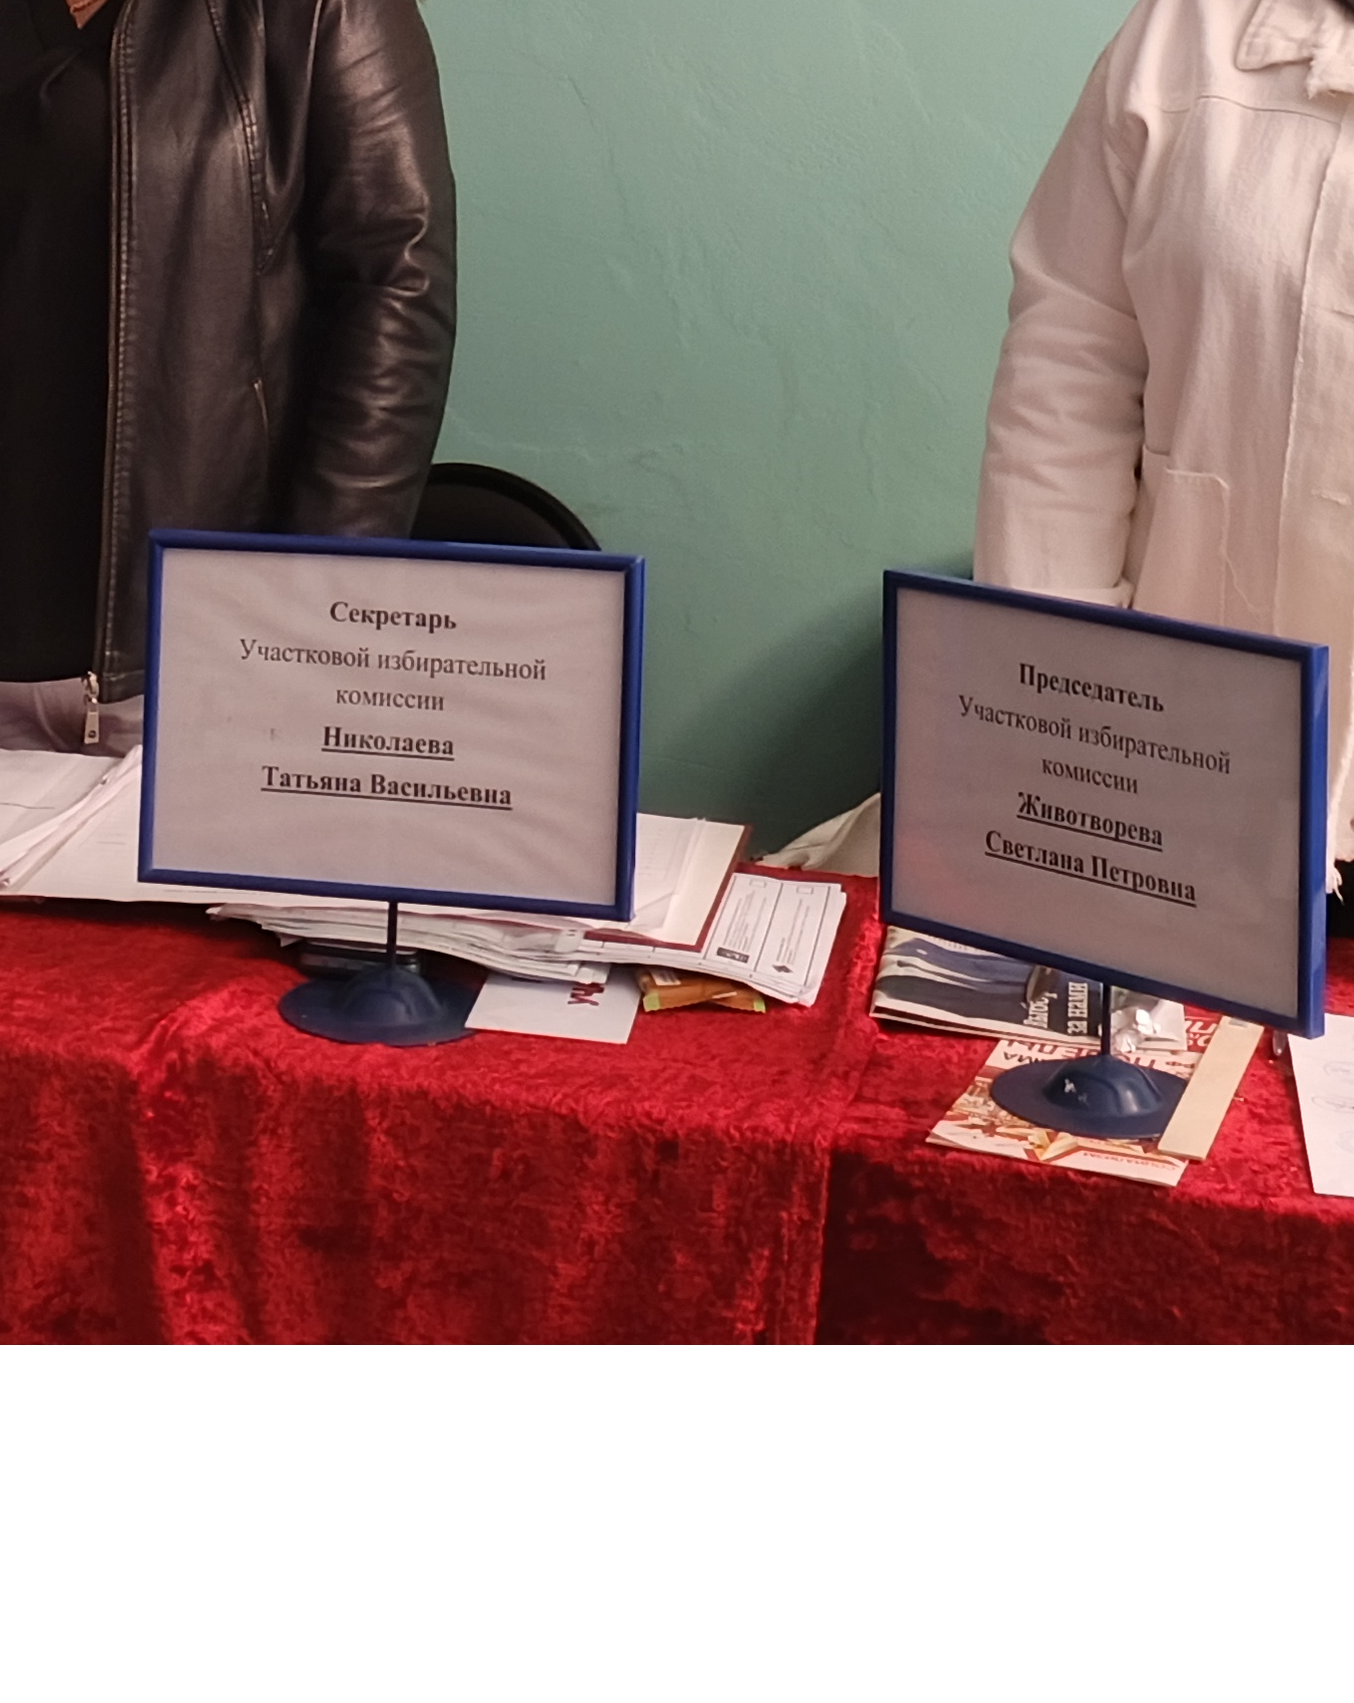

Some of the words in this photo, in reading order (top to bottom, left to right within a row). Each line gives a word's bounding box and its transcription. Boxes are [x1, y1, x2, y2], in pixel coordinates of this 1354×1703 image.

[329, 601, 457, 634] Секретарь
[239, 638, 370, 669] Участковой
[377, 650, 547, 681] избирательной
[335, 688, 446, 712] комиссии
[1019, 663, 1164, 712] Председатель
[322, 726, 455, 757] Николаева
[958, 694, 1072, 739] Участковой
[1078, 726, 1231, 774] избирательной
[261, 765, 362, 794] Татьяна
[370, 774, 513, 806] Васильевна
[1041, 758, 1138, 795] комиссии
[1017, 791, 1163, 847] Животворева
[985, 829, 1084, 874] Светлана
[1091, 855, 1196, 902] Петровна
[1067, 981, 1088, 1018] нами
